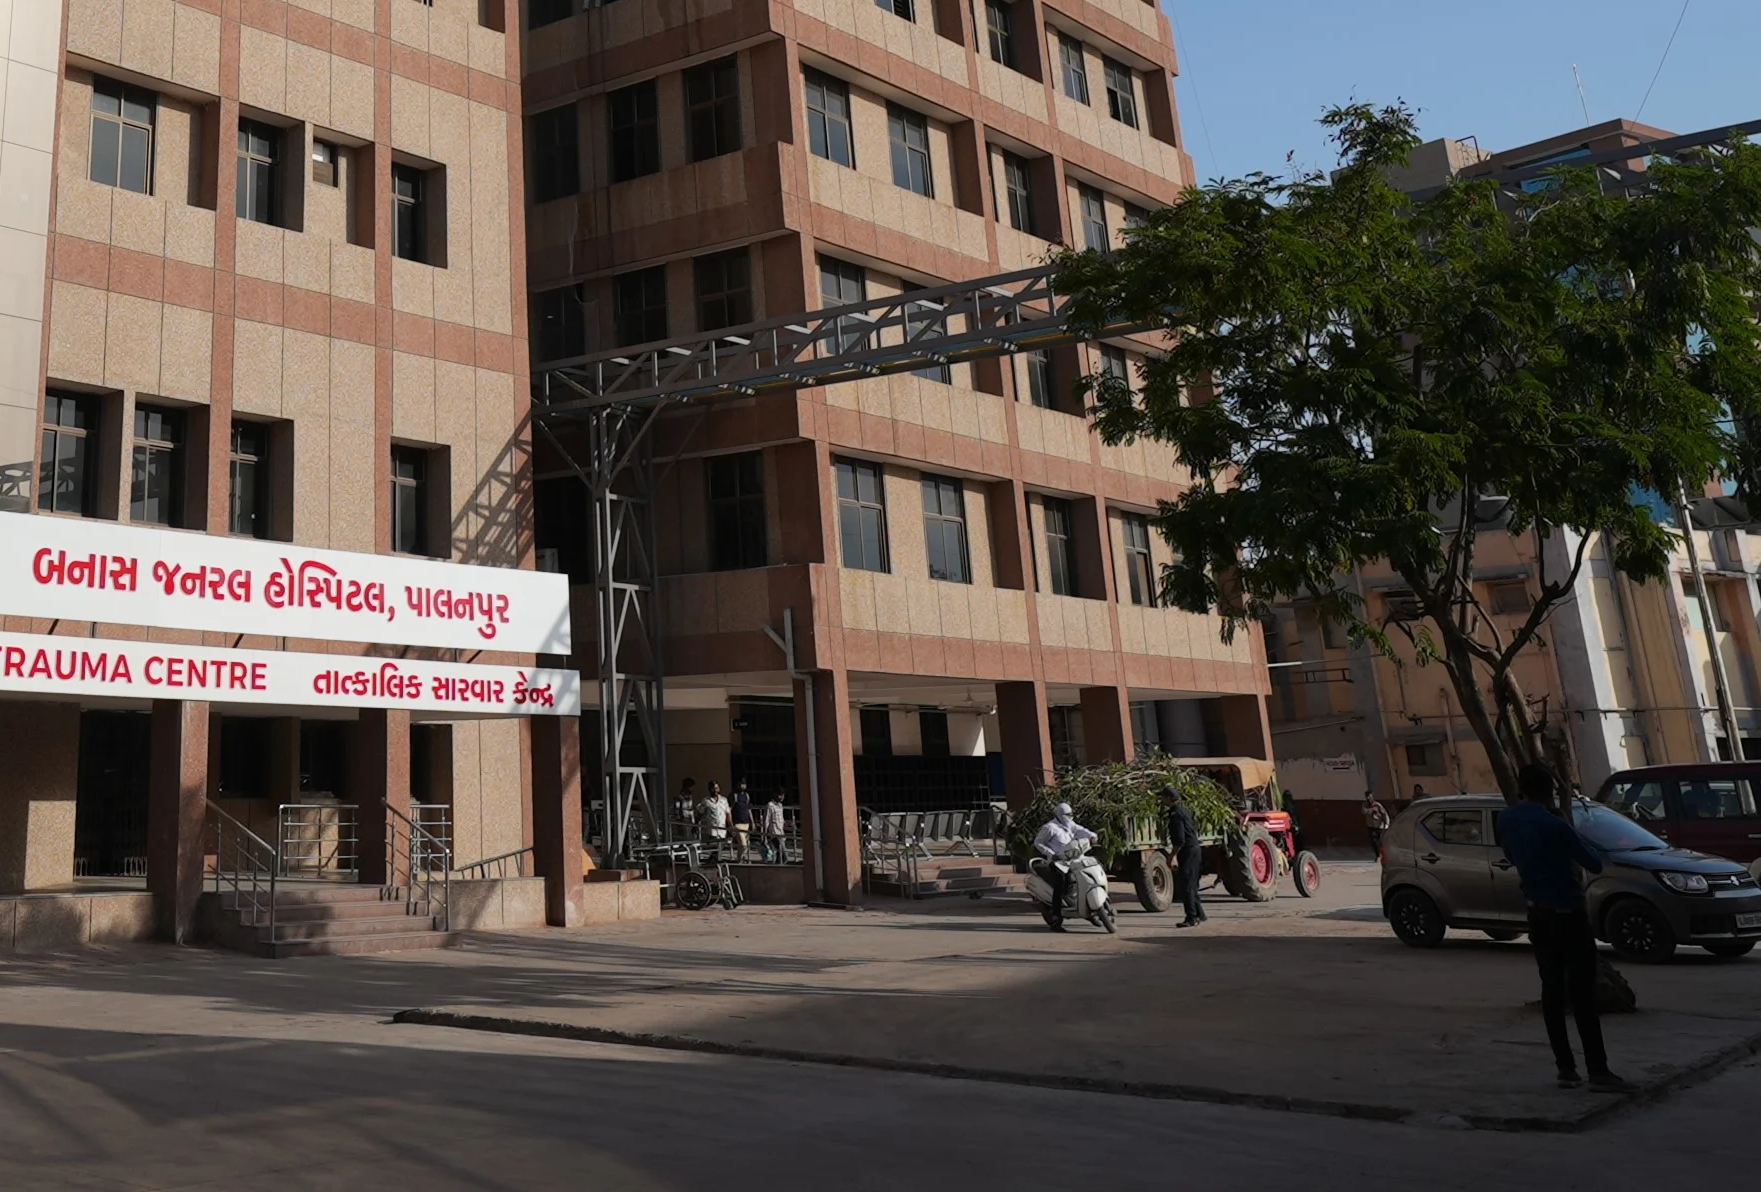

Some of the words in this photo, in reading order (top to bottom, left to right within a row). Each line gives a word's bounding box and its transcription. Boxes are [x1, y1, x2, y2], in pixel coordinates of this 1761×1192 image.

[32, 547, 139, 593] બનાસ
[153, 560, 252, 604] જનરલ
[263, 558, 396, 622] હોસ્પિટલ,
[405, 585, 510, 640] પાલનપુર
[143, 655, 268, 691] CENTRE
[313, 661, 423, 700] તાત્કાલિક
[431, 676, 505, 705] સારવાર
[512, 670, 555, 708] કેન્દ્ર
